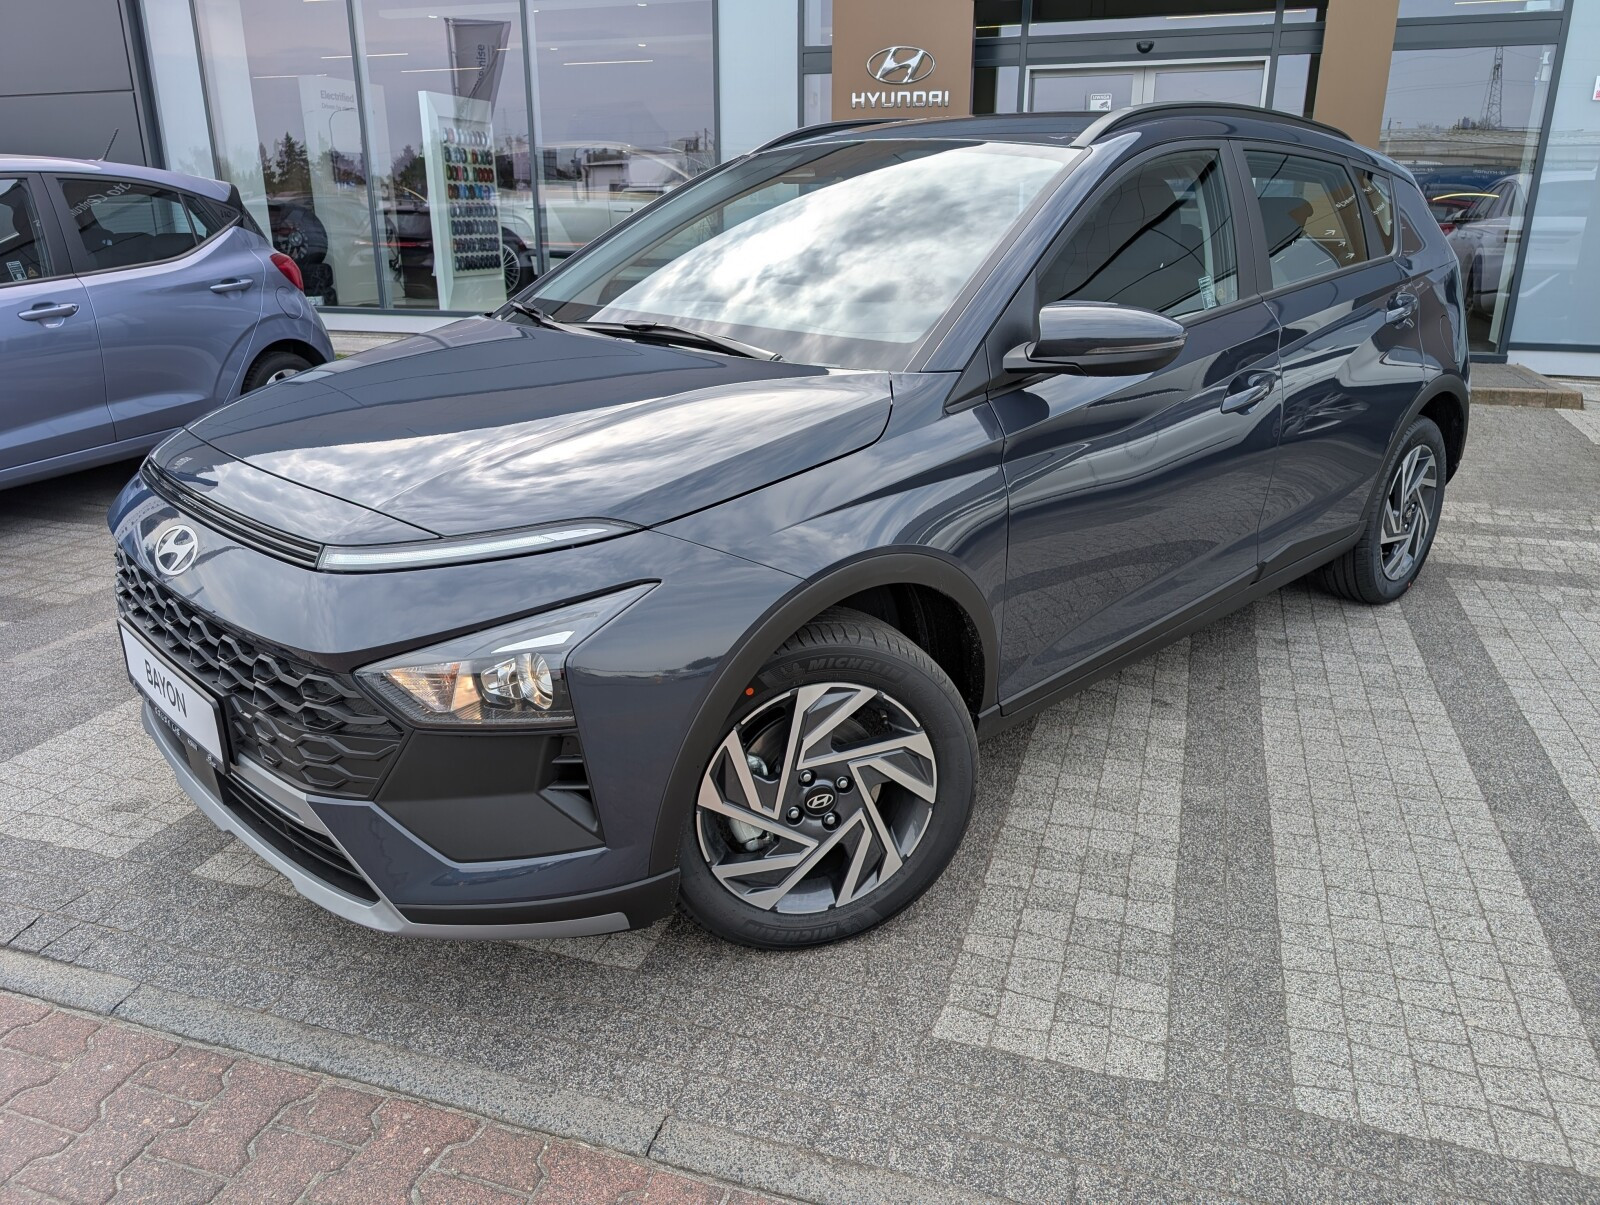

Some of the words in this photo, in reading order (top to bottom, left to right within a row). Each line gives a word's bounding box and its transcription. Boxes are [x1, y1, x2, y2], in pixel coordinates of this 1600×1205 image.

[320, 89, 355, 103] Electrified
[851, 90, 949, 108] HYUNDAI
[808, 657, 904, 679] MICHELIN
[144, 659, 187, 718] BAYON
[746, 921, 838, 942] MICHELIN
